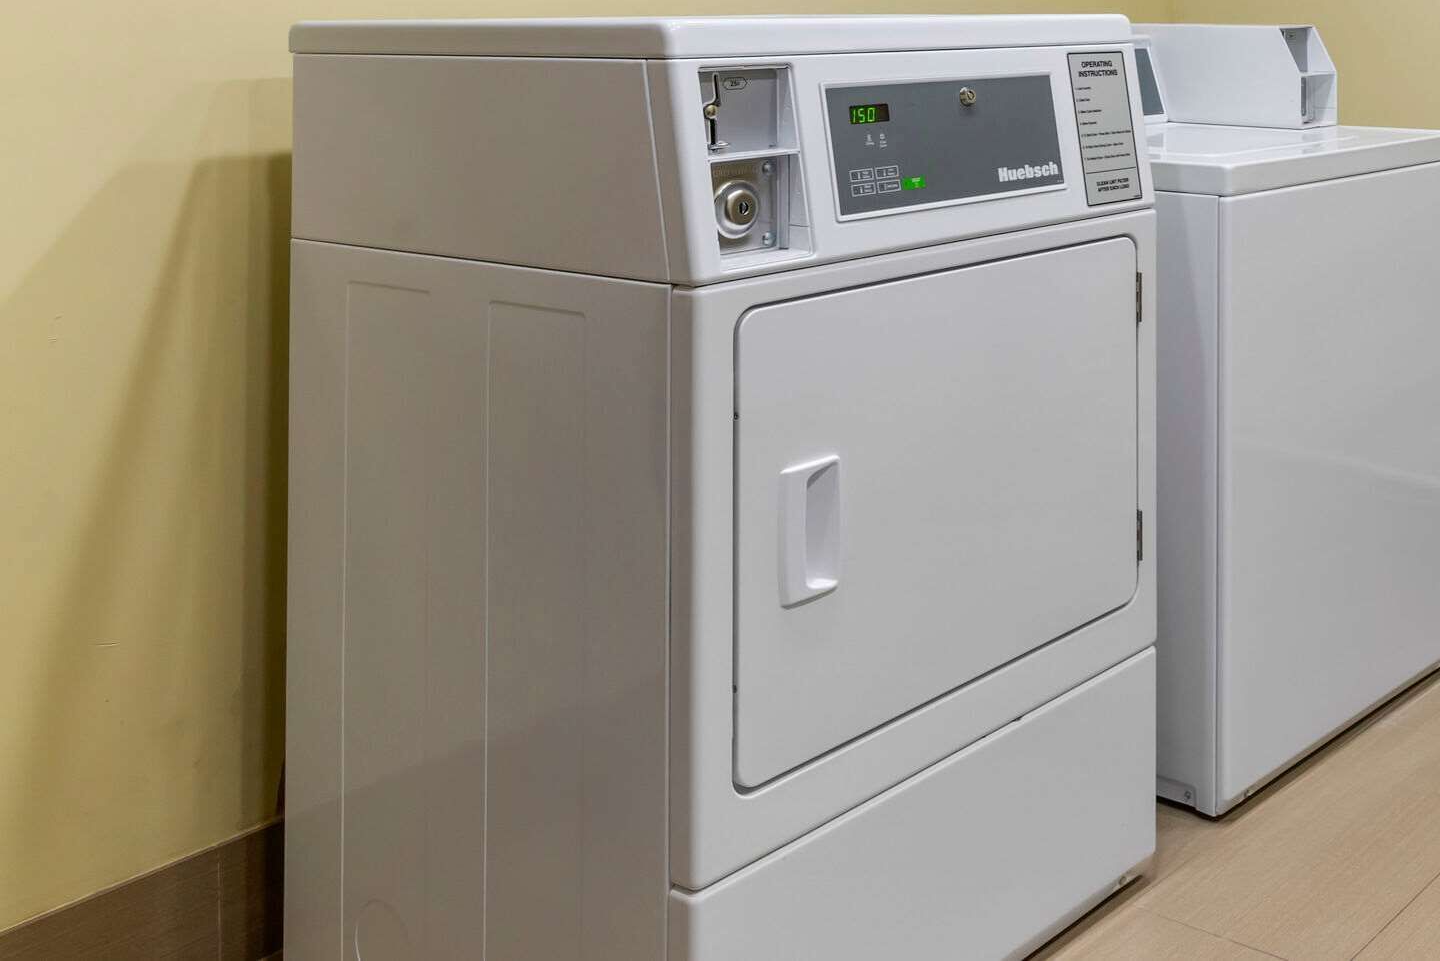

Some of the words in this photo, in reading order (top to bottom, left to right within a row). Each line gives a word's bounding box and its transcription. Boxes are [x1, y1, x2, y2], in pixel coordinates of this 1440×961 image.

[1081, 60, 1113, 68] OPERATING
[1078, 69, 1118, 78] INSTRUCTIONS
[852, 107, 876, 124] 150
[997, 161, 1059, 183] Huebsch
